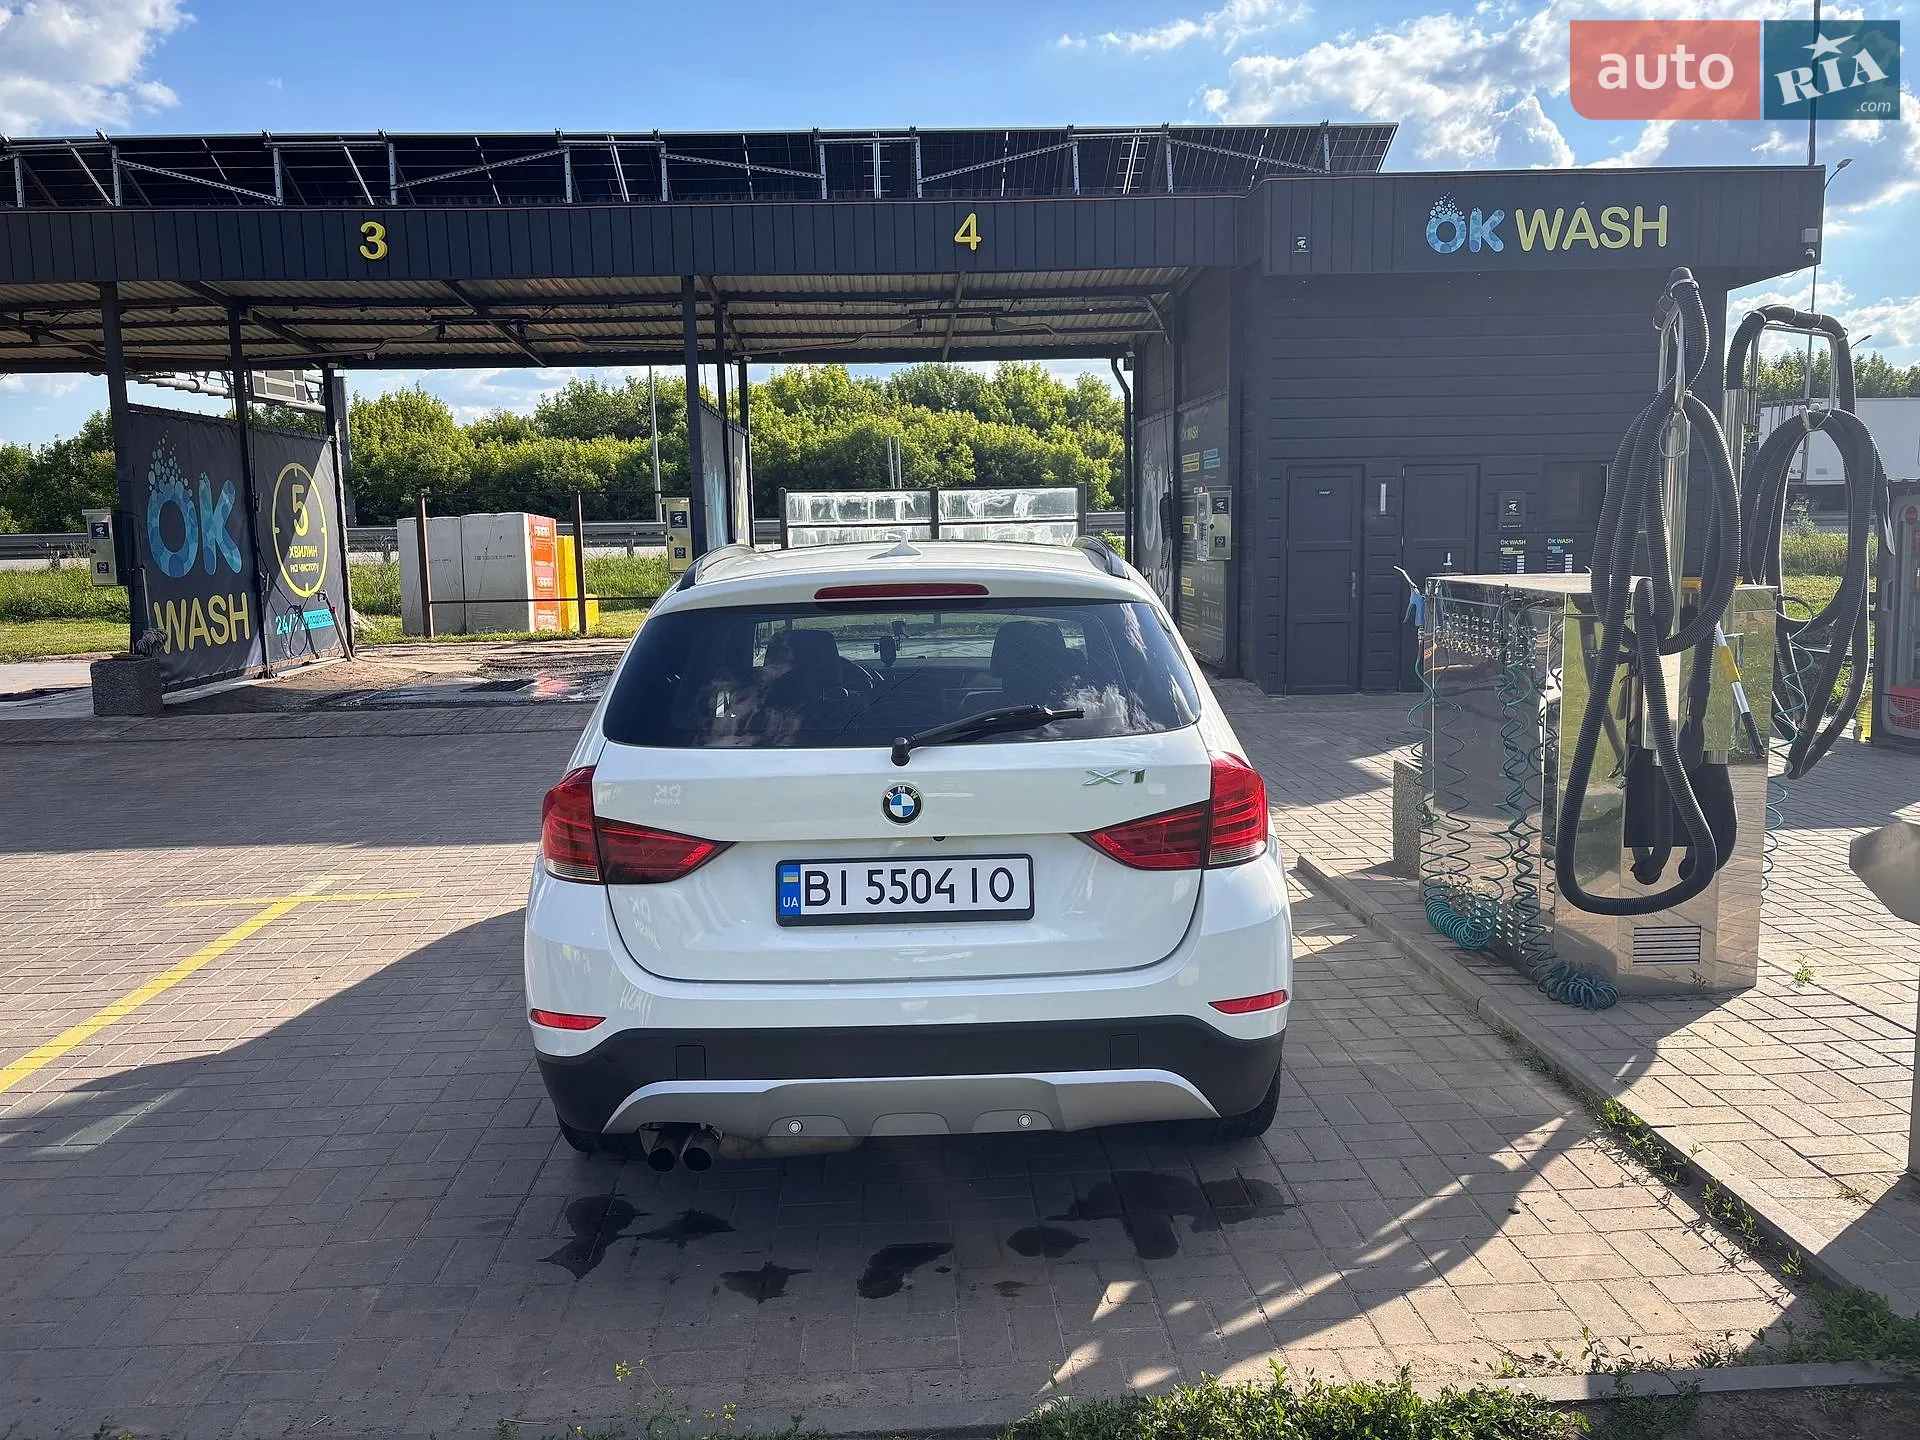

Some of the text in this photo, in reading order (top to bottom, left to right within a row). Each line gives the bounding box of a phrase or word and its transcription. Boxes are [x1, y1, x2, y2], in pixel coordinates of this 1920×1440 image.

[359, 222, 388, 260] 3
[954, 213, 981, 251] 4
[1426, 205, 1667, 253] OK WASH
[147, 468, 242, 578] OK
[291, 484, 309, 536] 5
[289, 545, 318, 558] ХВИЛИН
[290, 563, 298, 573] на
[154, 592, 250, 654] WASH
[886, 786, 919, 799] BMW
[1083, 768, 1146, 785] X1
[783, 897, 799, 908] UA
[804, 867, 1015, 906] BI 5504 IO
